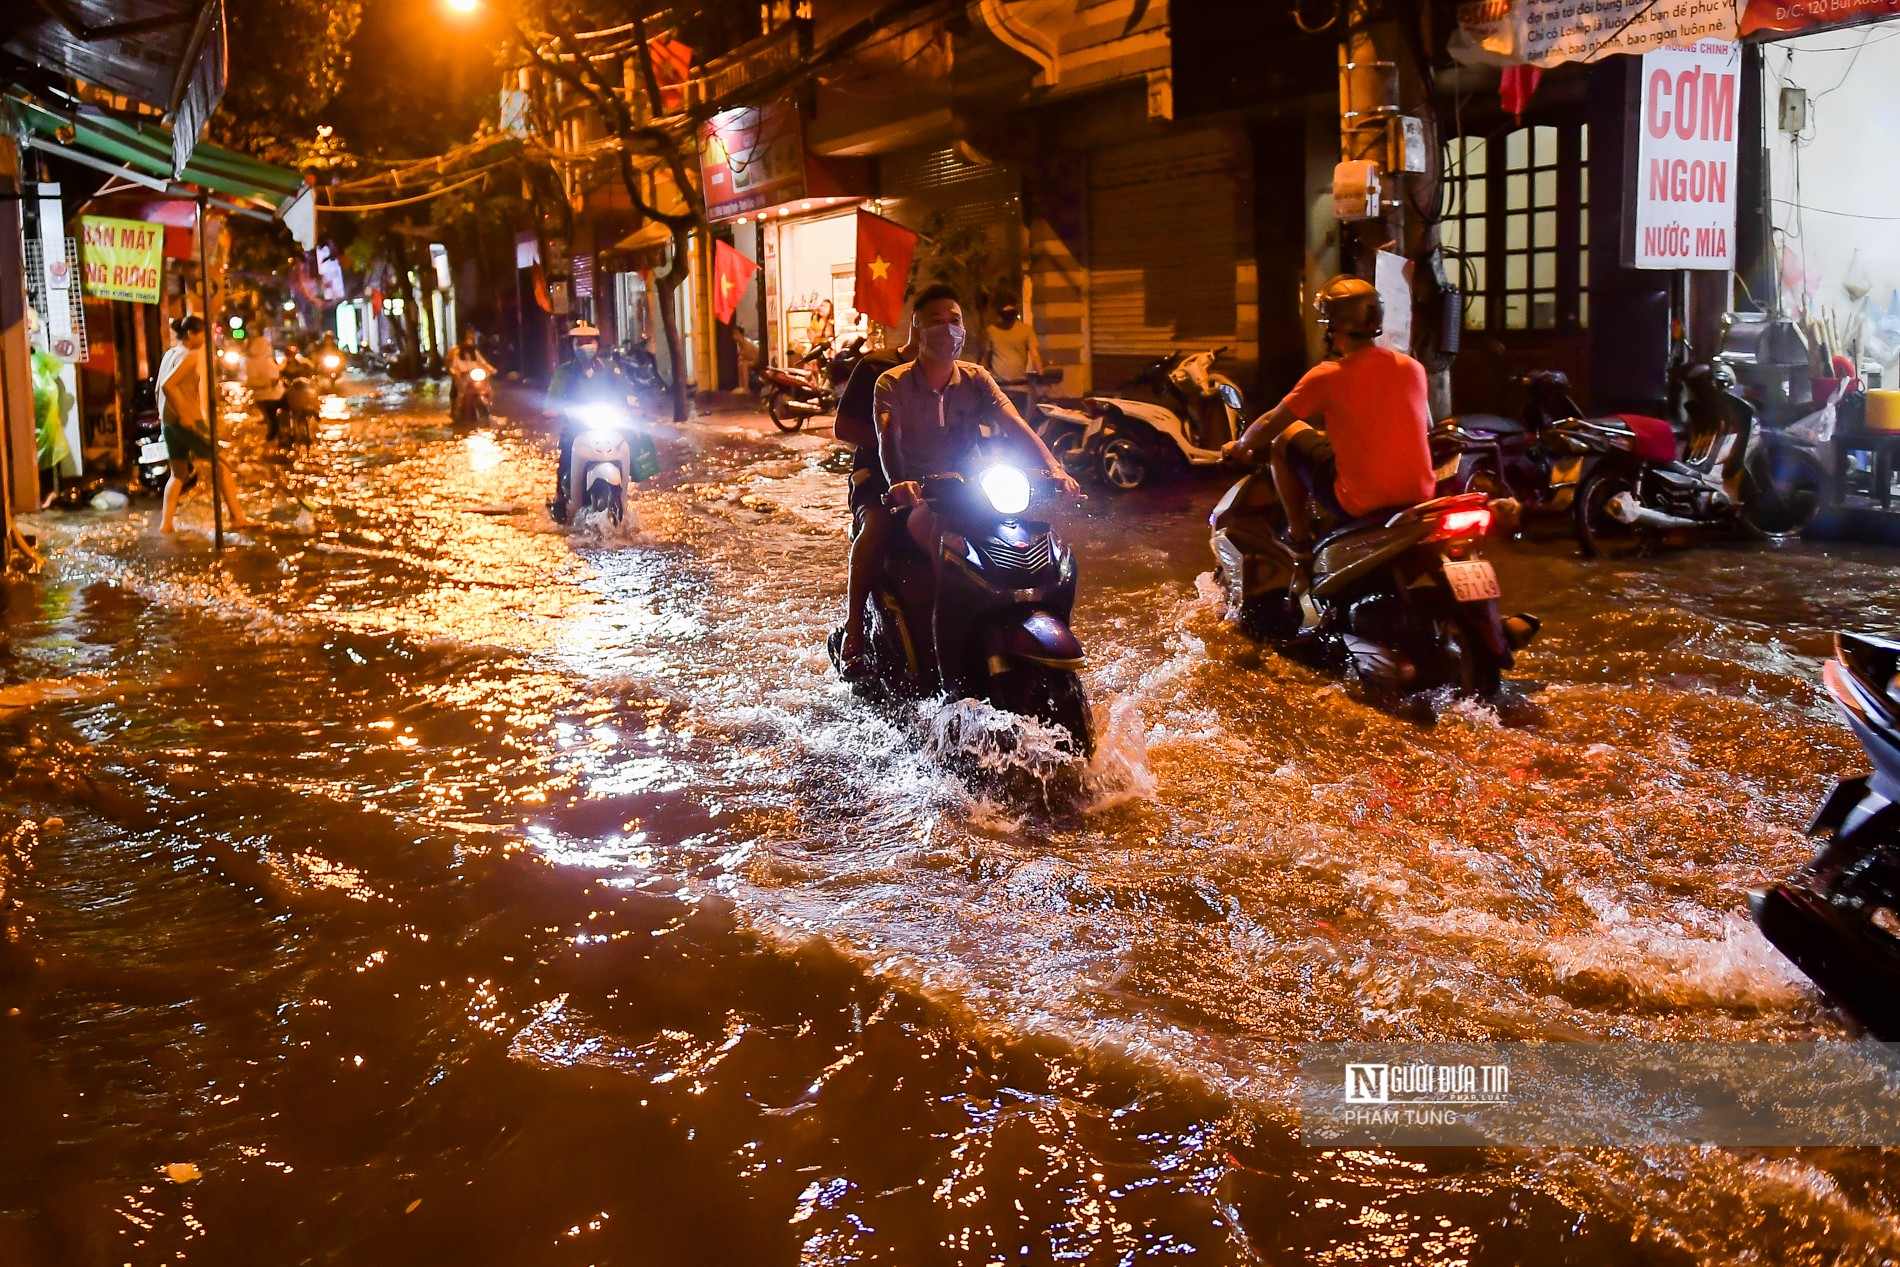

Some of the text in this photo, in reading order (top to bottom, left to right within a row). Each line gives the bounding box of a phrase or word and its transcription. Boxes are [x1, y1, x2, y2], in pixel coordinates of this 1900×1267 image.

[1650, 9, 1669, 23] bạn
[1673, 1, 1687, 18] để
[1690, 1, 1719, 19] phục
[1808, 1, 1828, 14] 120
[1627, 33, 1646, 45] bao
[1650, 28, 1677, 44] ngon
[1680, 23, 1705, 37] luôn
[1648, 65, 1735, 141] CƠM
[1649, 159, 1727, 203] NGON
[1644, 221, 1727, 258] NƯỚC MÍA
